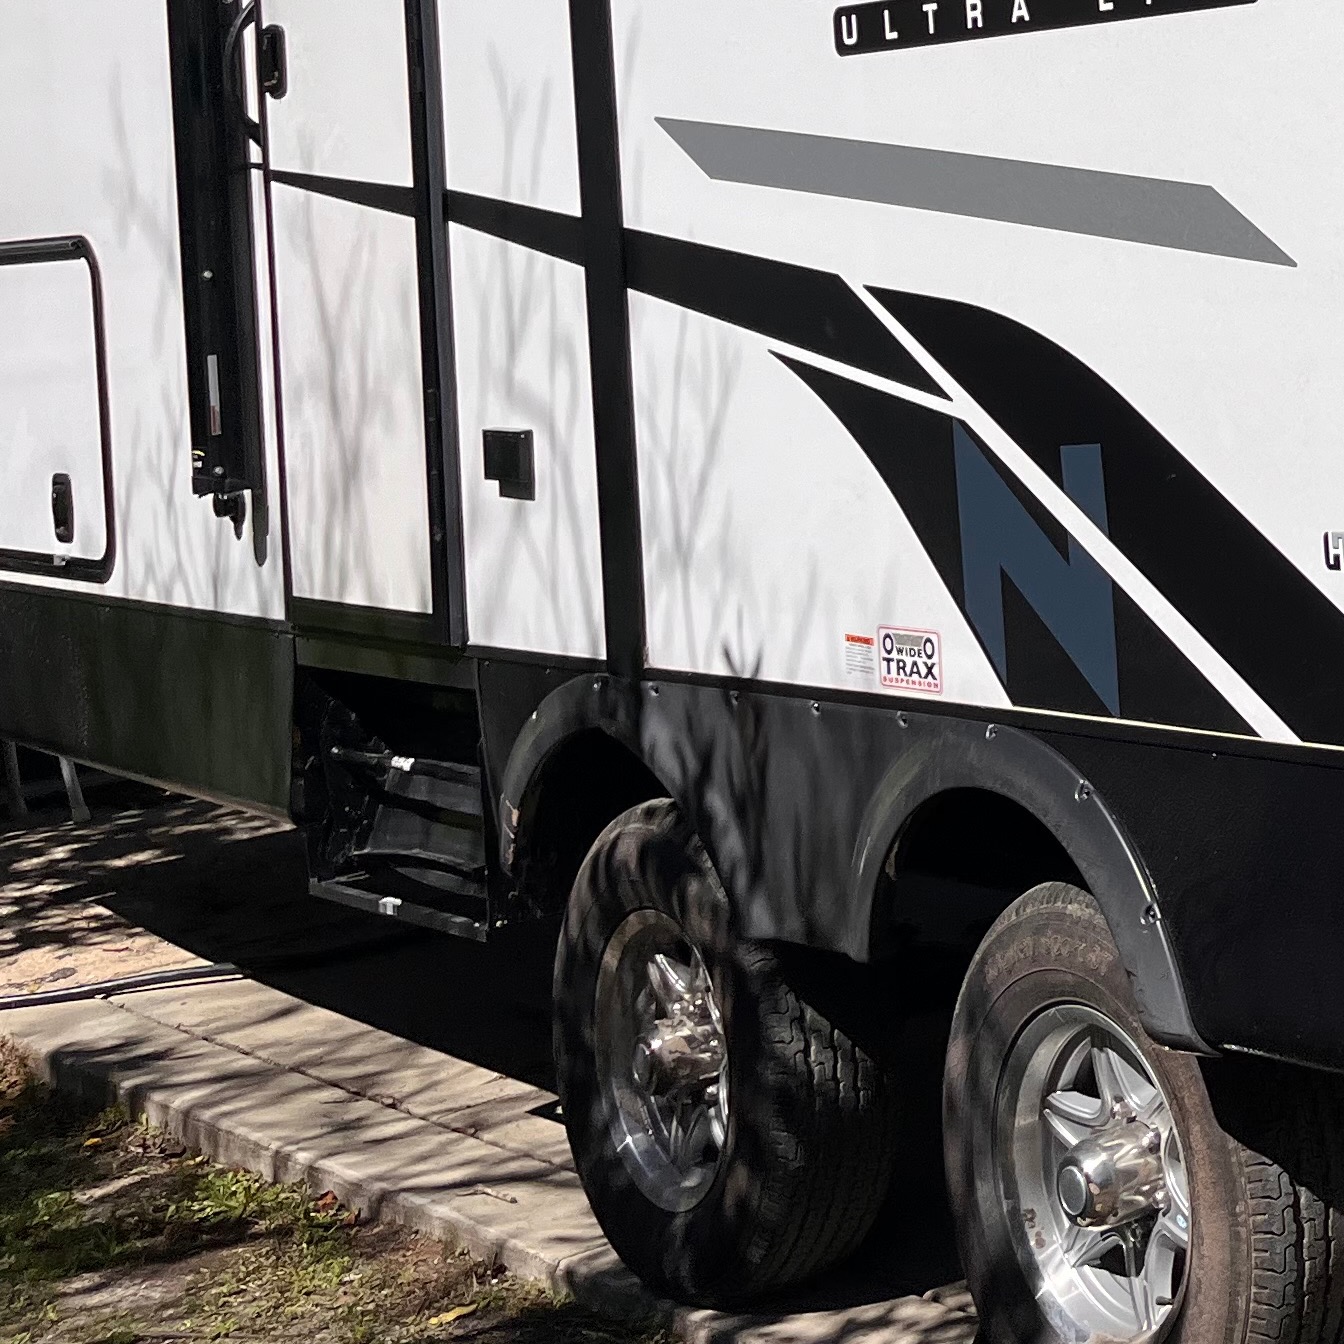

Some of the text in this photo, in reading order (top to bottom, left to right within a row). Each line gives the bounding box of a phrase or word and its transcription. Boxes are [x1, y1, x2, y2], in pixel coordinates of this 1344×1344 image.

[895, 645, 923, 658] WIDE
[882, 657, 938, 681] TRAX
[882, 676, 939, 689] SUSPENSION
